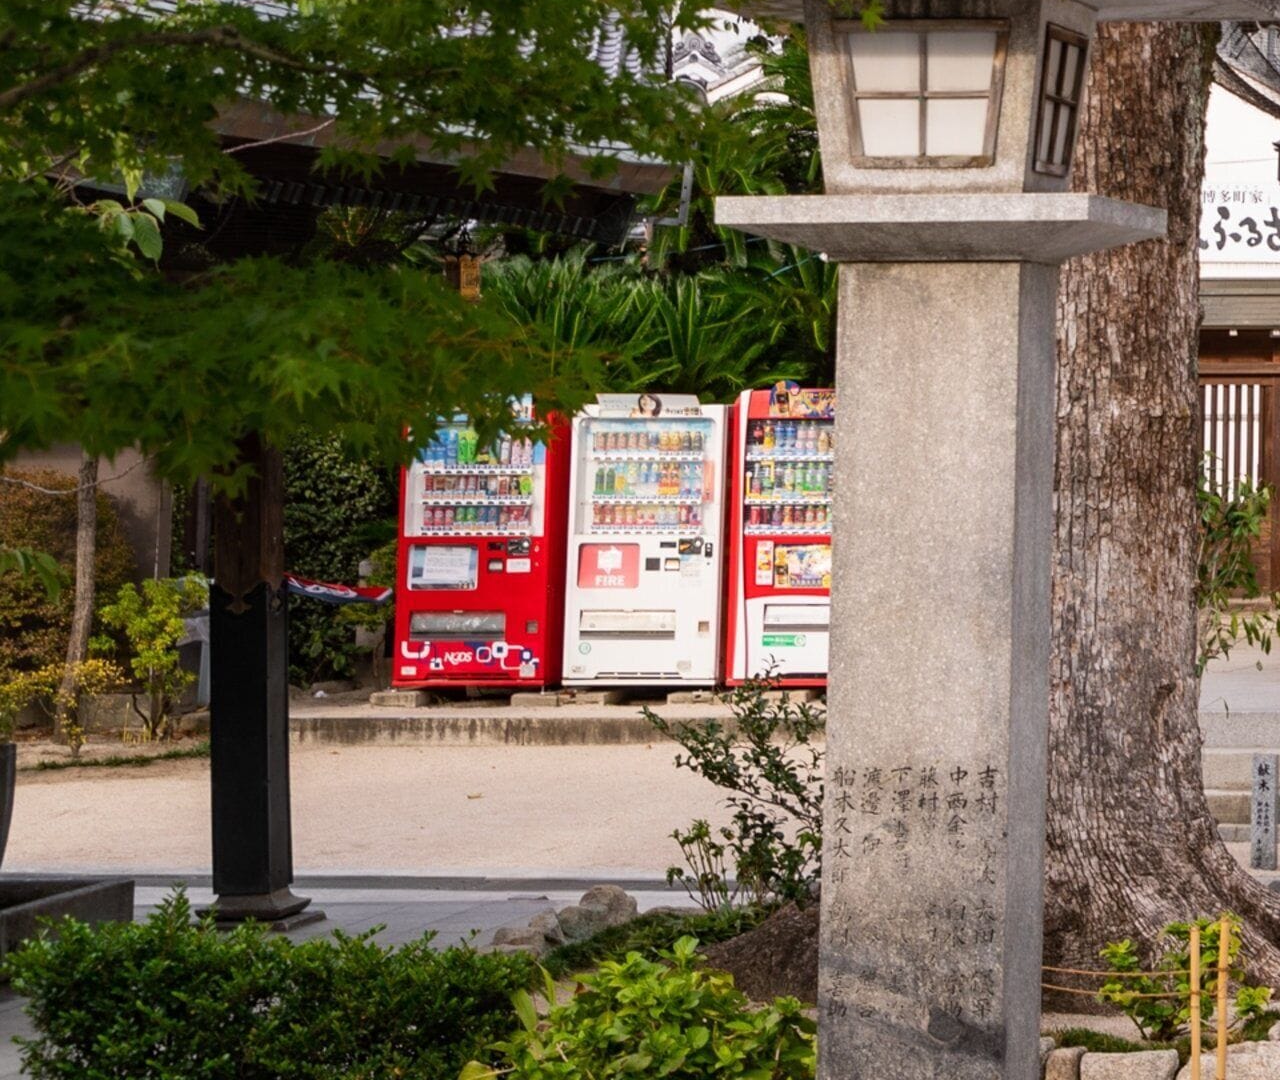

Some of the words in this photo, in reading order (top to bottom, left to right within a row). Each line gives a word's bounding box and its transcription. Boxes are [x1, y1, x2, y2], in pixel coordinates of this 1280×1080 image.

[1202, 189, 1263, 204] 博多町家
[595, 575, 626, 587] FIRE
